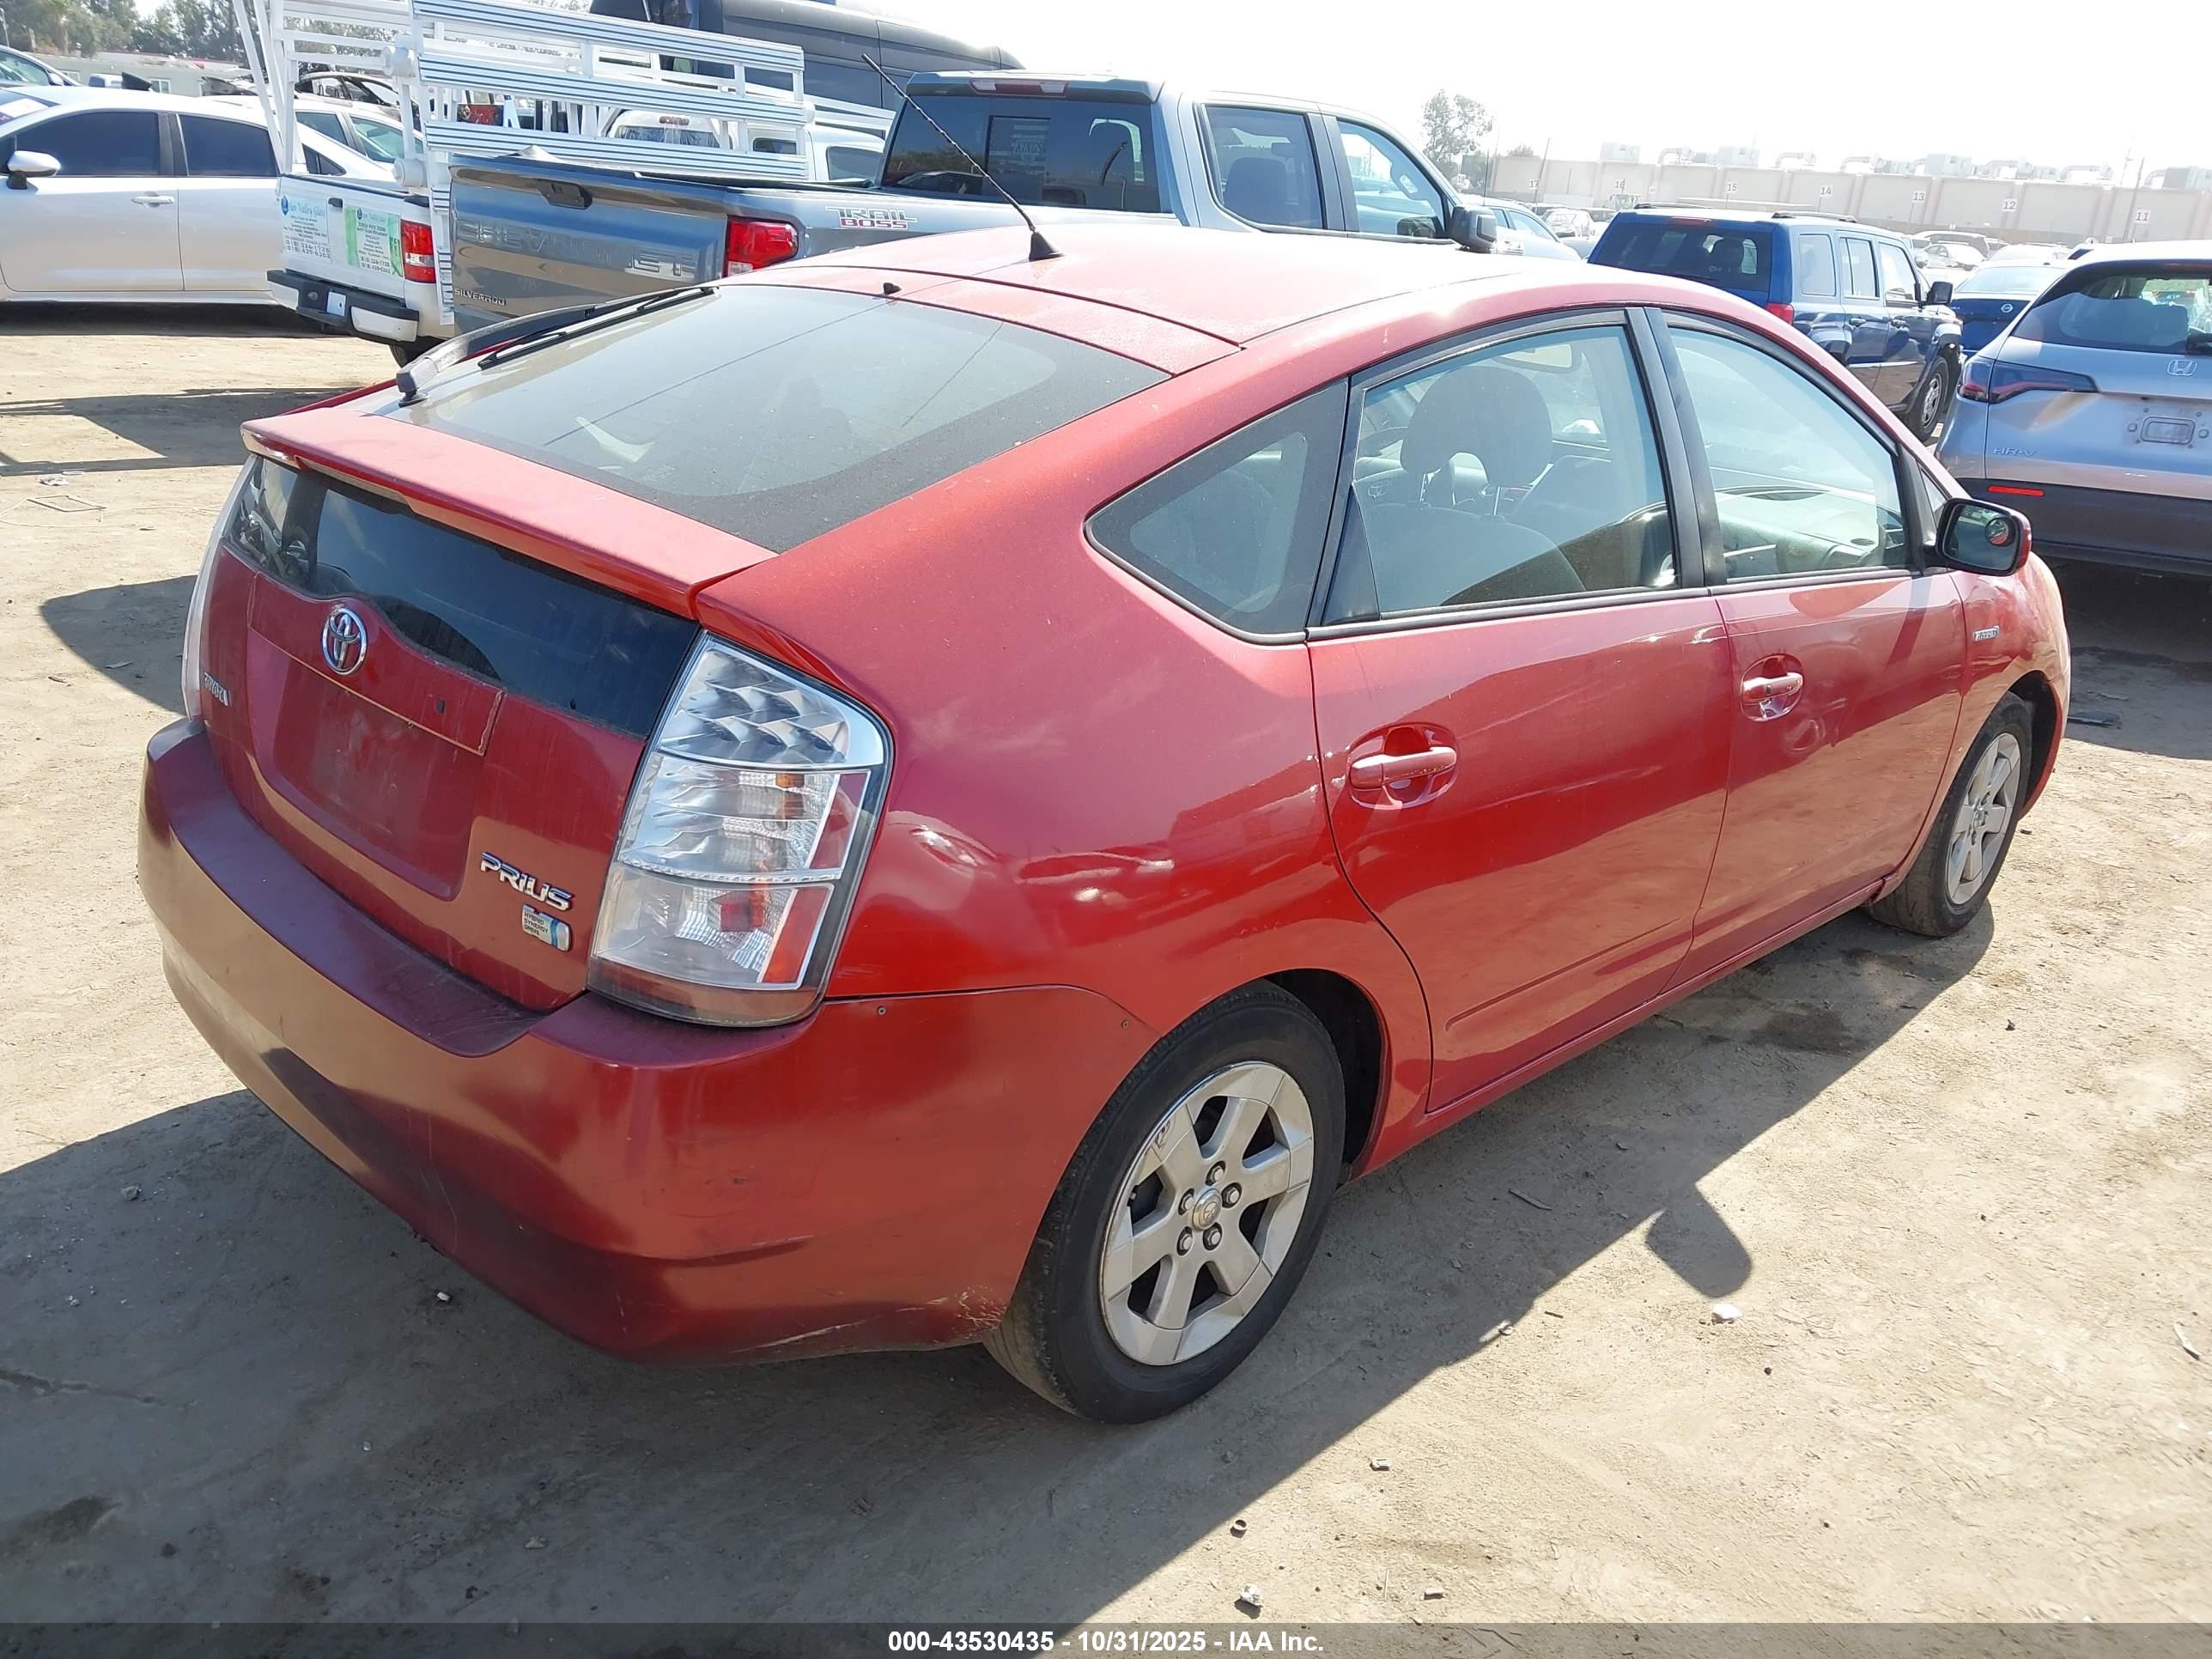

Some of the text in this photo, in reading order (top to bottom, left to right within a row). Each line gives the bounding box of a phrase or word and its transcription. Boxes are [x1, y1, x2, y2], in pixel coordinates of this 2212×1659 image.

[1728, 183, 1737, 191] 15
[1820, 186, 1832, 195] 14
[1913, 191, 1924, 201] 13
[2003, 201, 2015, 210] 12
[824, 205, 918, 222] TRAIL
[2136, 212, 2149, 222] 11
[840, 217, 908, 230] BOSS
[454, 288, 507, 306] SILVERADO
[1992, 447, 2038, 457] HR-V
[481, 852, 574, 911] PRIUS
[524, 912, 544, 926] HYBRID
[524, 918, 549, 934] SYNERGY
[524, 924, 540, 936] DRIVE
